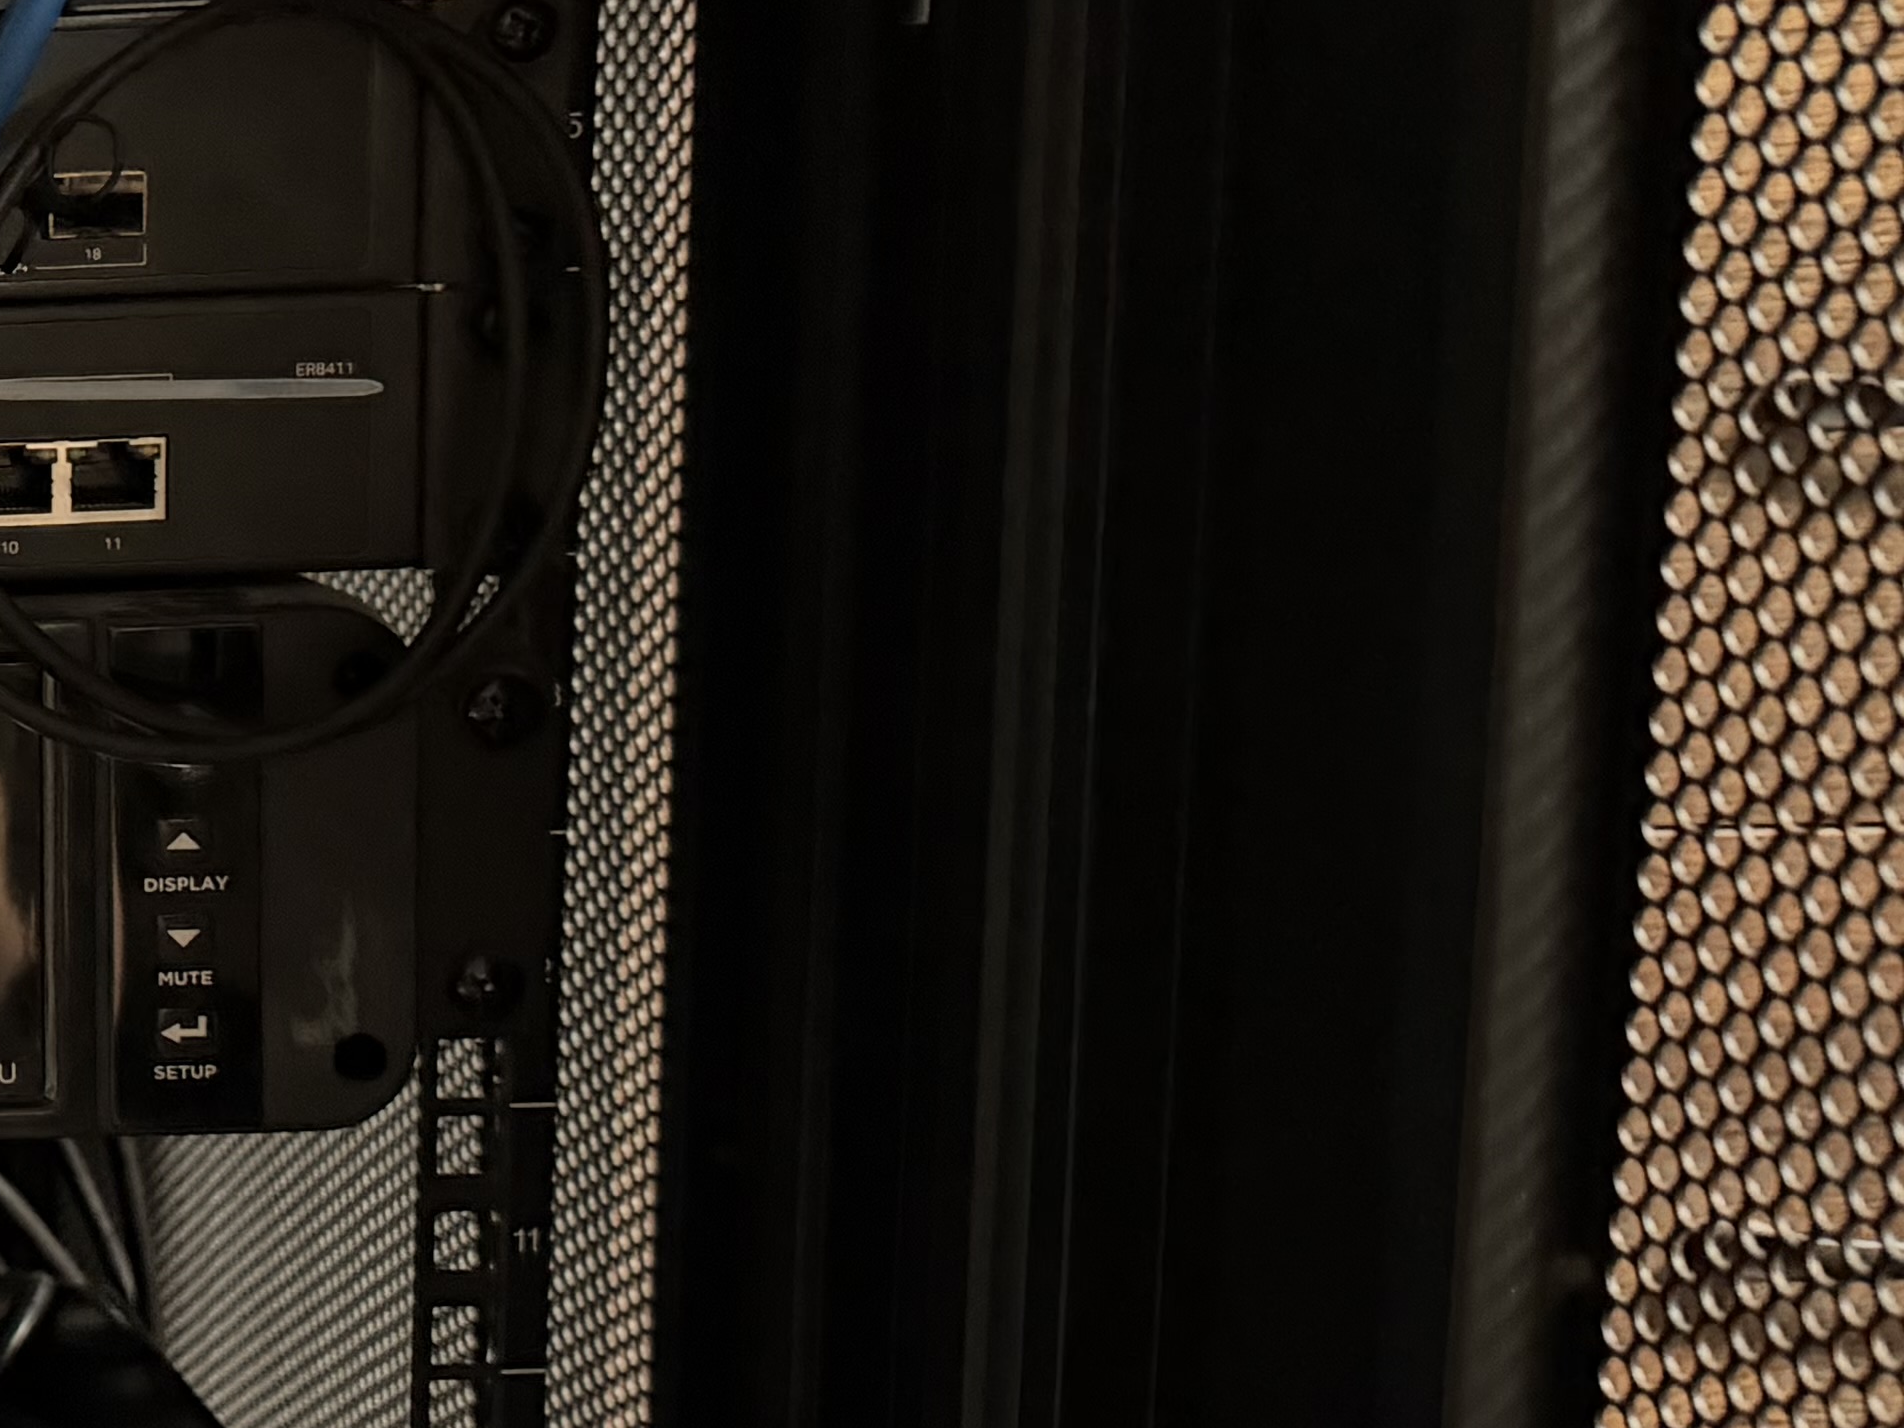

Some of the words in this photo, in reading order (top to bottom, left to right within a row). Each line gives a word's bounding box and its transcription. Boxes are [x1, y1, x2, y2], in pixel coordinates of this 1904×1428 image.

[85, 247, 102, 261] 18
[295, 361, 354, 377] ER8411
[1, 540, 19, 555] 10
[105, 537, 121, 551] 11
[143, 875, 229, 894] DISPLAY
[158, 970, 213, 987] MUTE
[153, 1062, 217, 1082] SETUP
[513, 1225, 539, 1253] 11
